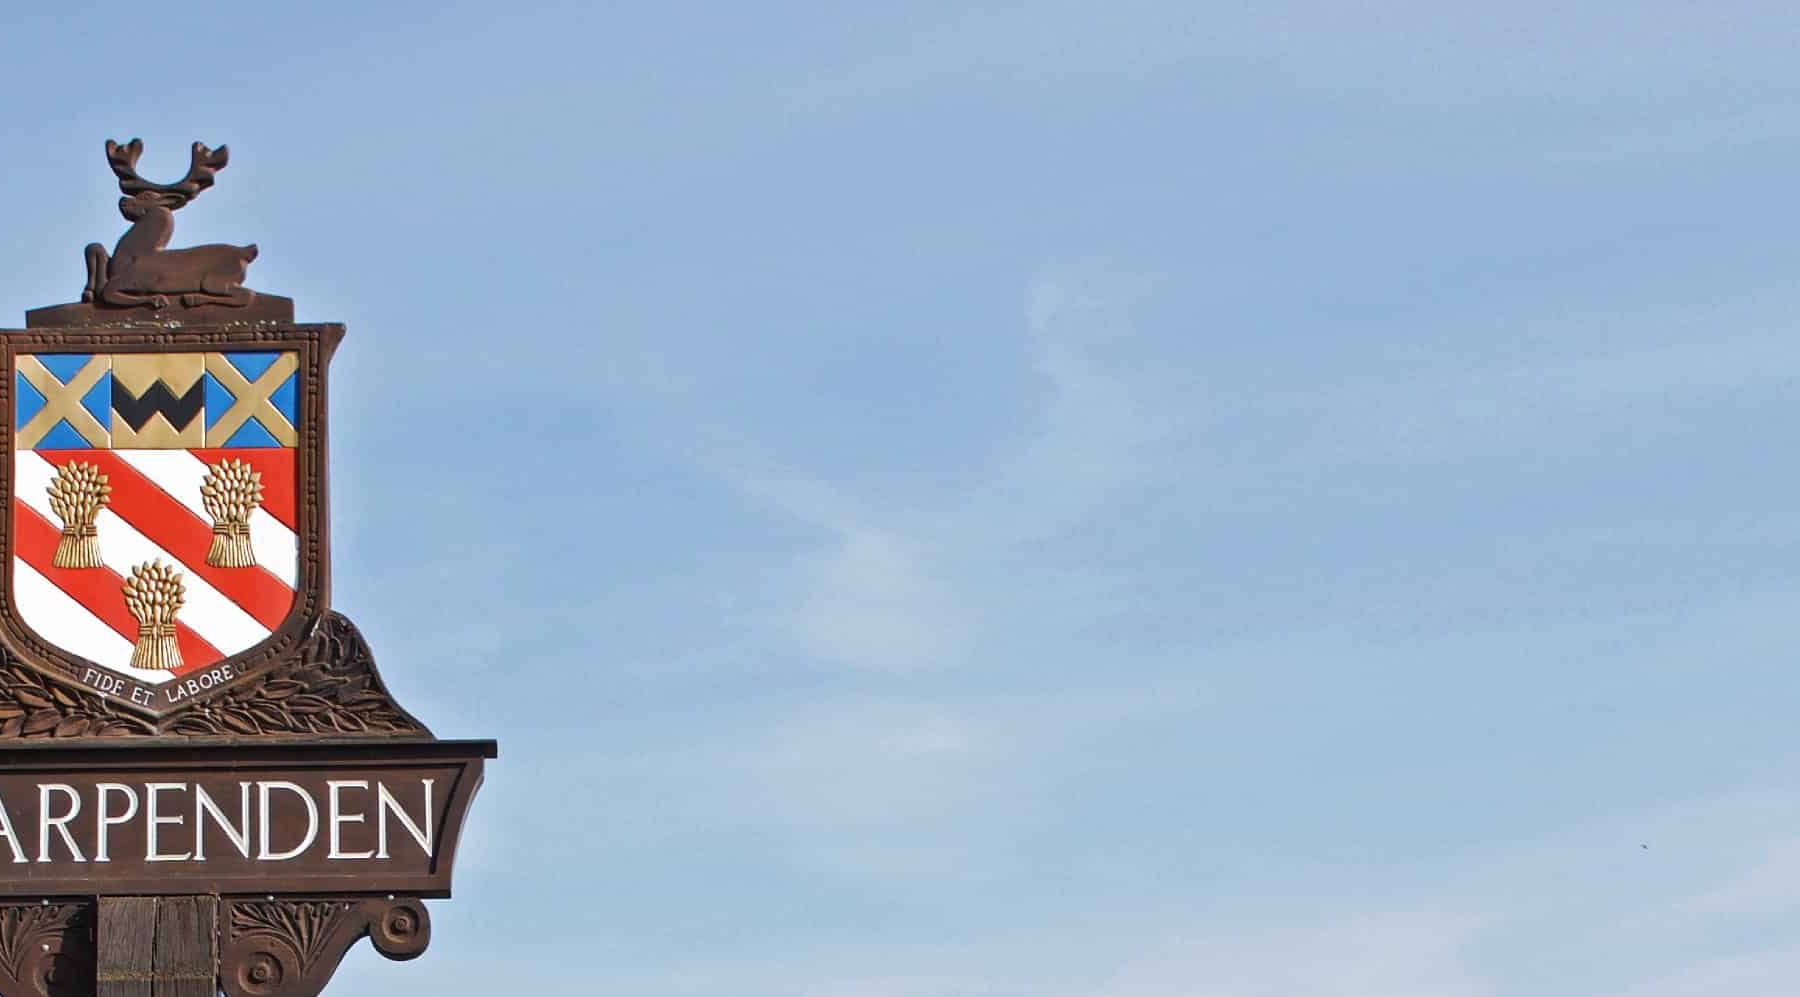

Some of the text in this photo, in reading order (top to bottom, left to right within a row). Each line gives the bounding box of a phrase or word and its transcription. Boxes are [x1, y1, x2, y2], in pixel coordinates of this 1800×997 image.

[82, 664, 235, 706] FIDE ET LABORE
